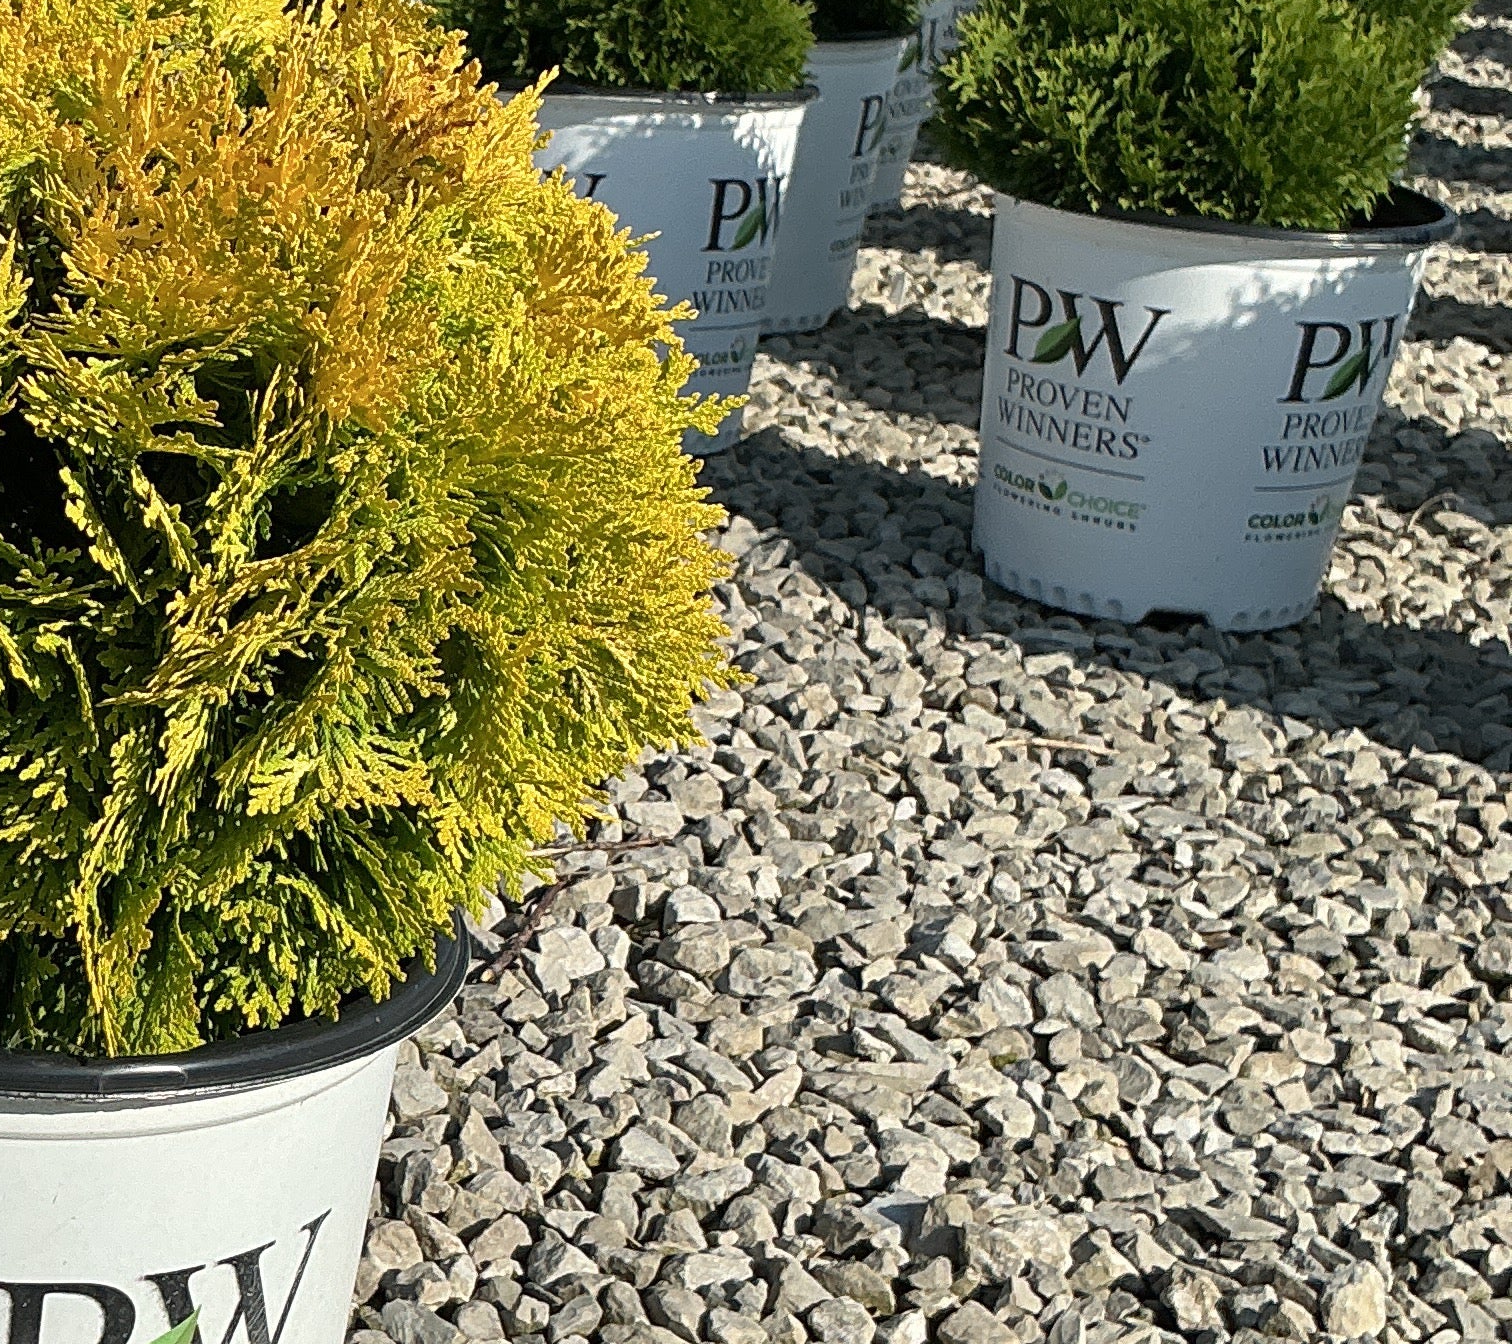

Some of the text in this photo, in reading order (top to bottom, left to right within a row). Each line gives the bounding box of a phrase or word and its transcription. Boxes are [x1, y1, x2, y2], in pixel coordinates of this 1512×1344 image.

[1004, 273, 1172, 386] PW
[1006, 367, 1134, 424] PROVEN
[1280, 405, 1373, 441] PROVE
[993, 463, 1035, 493] COLOR
